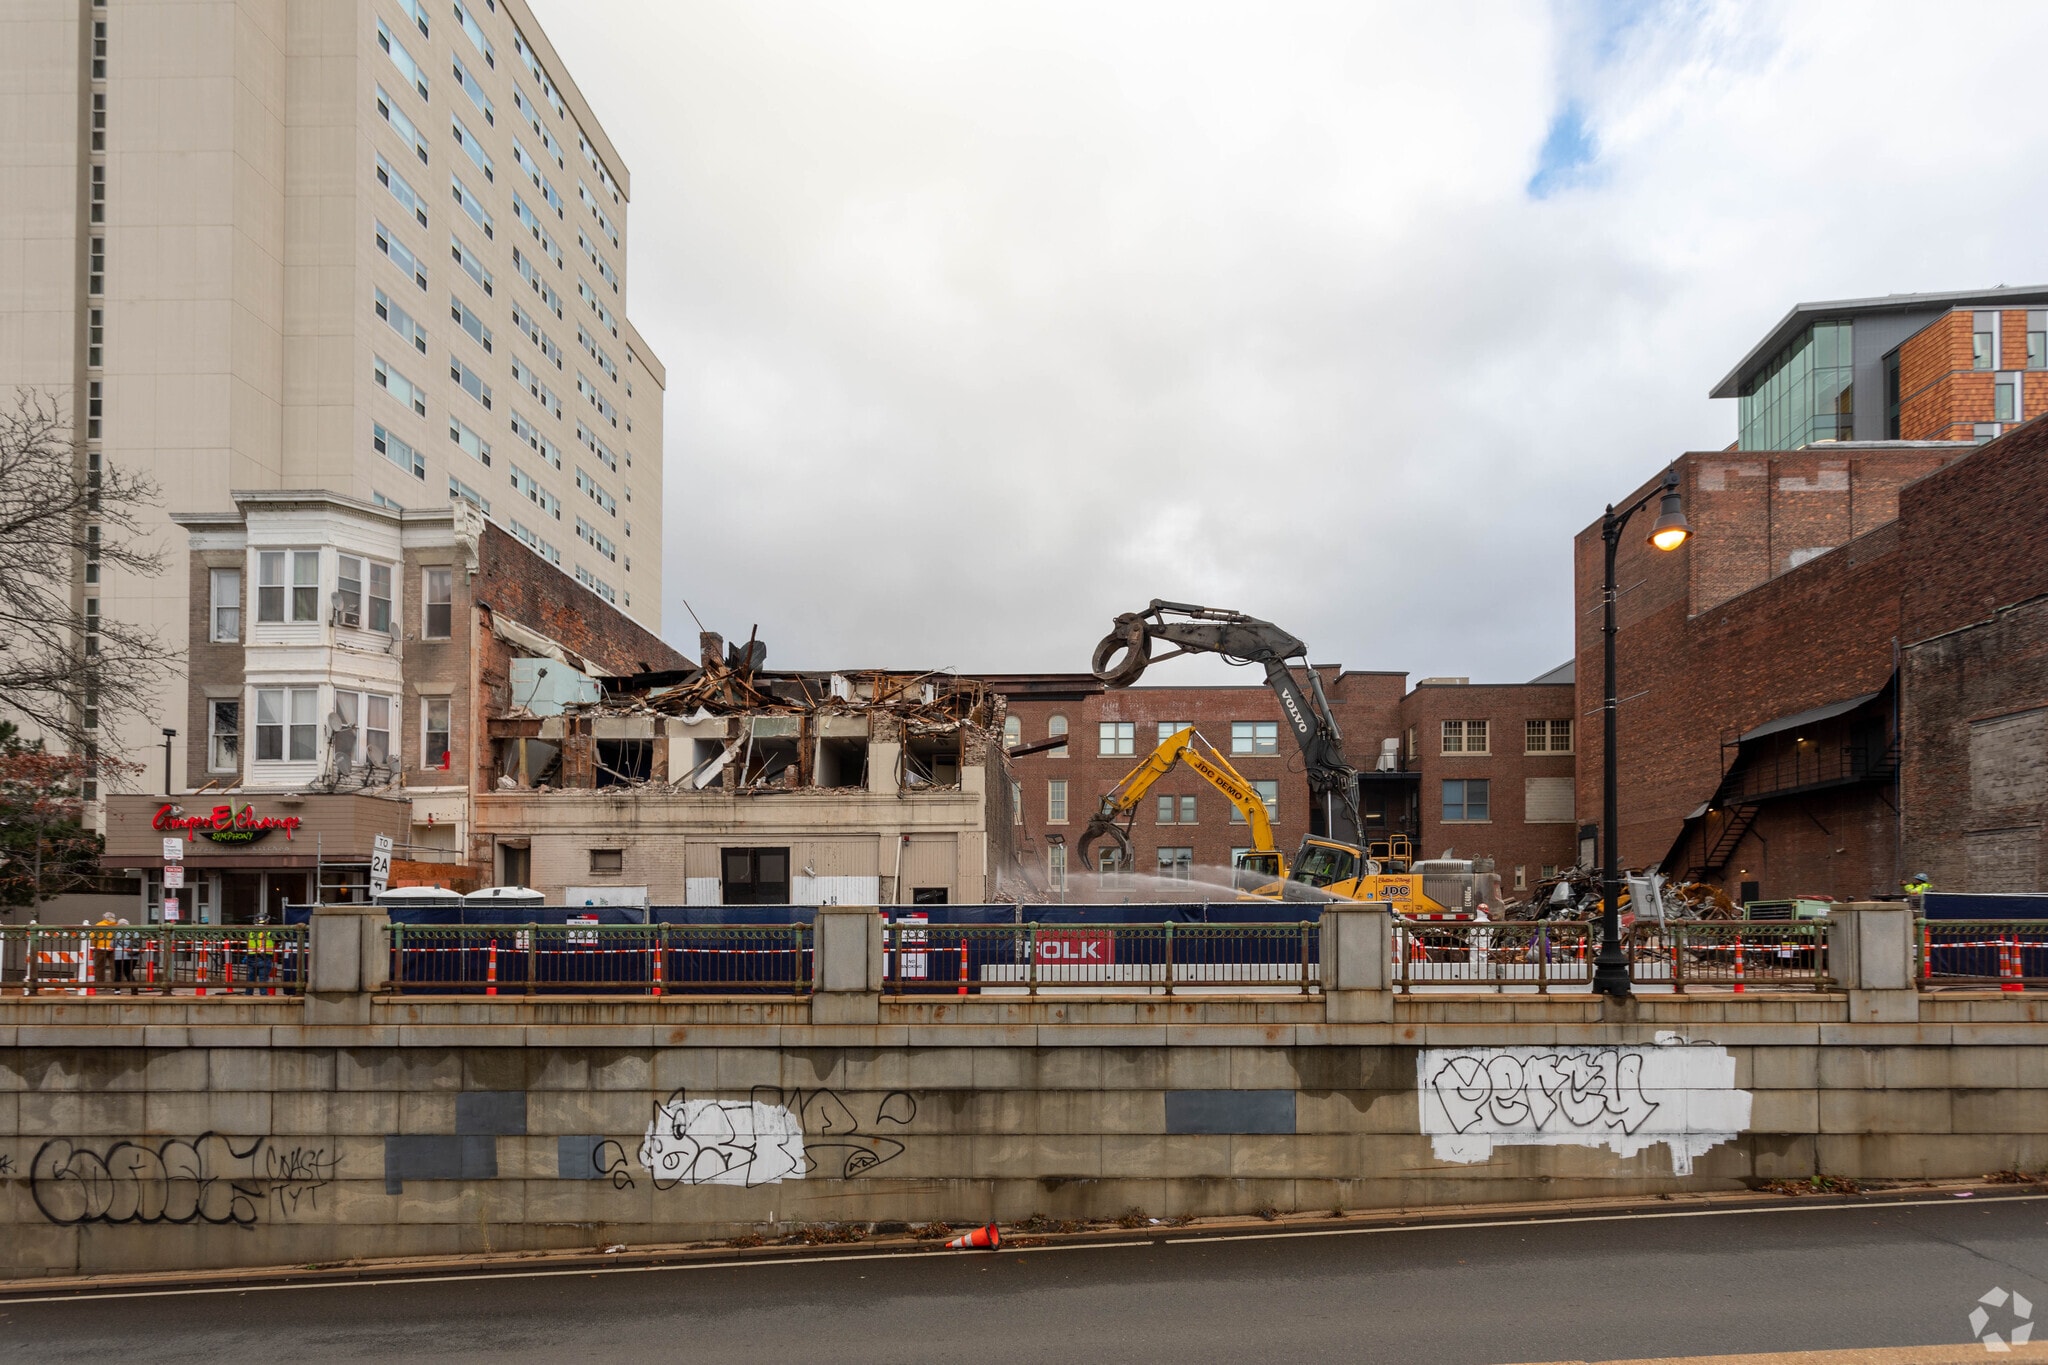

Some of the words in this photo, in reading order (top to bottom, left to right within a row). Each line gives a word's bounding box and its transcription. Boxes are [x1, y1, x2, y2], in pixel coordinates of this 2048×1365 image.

[1282, 688, 1307, 732] VOLVO
[1194, 762, 1215, 778] JDC
[1215, 777, 1242, 800] DEMO
[211, 831, 254, 842] SYMPHONY
[379, 838, 389, 848] TO
[373, 856, 388, 873] 2A
[1380, 886, 1410, 896] JDC
